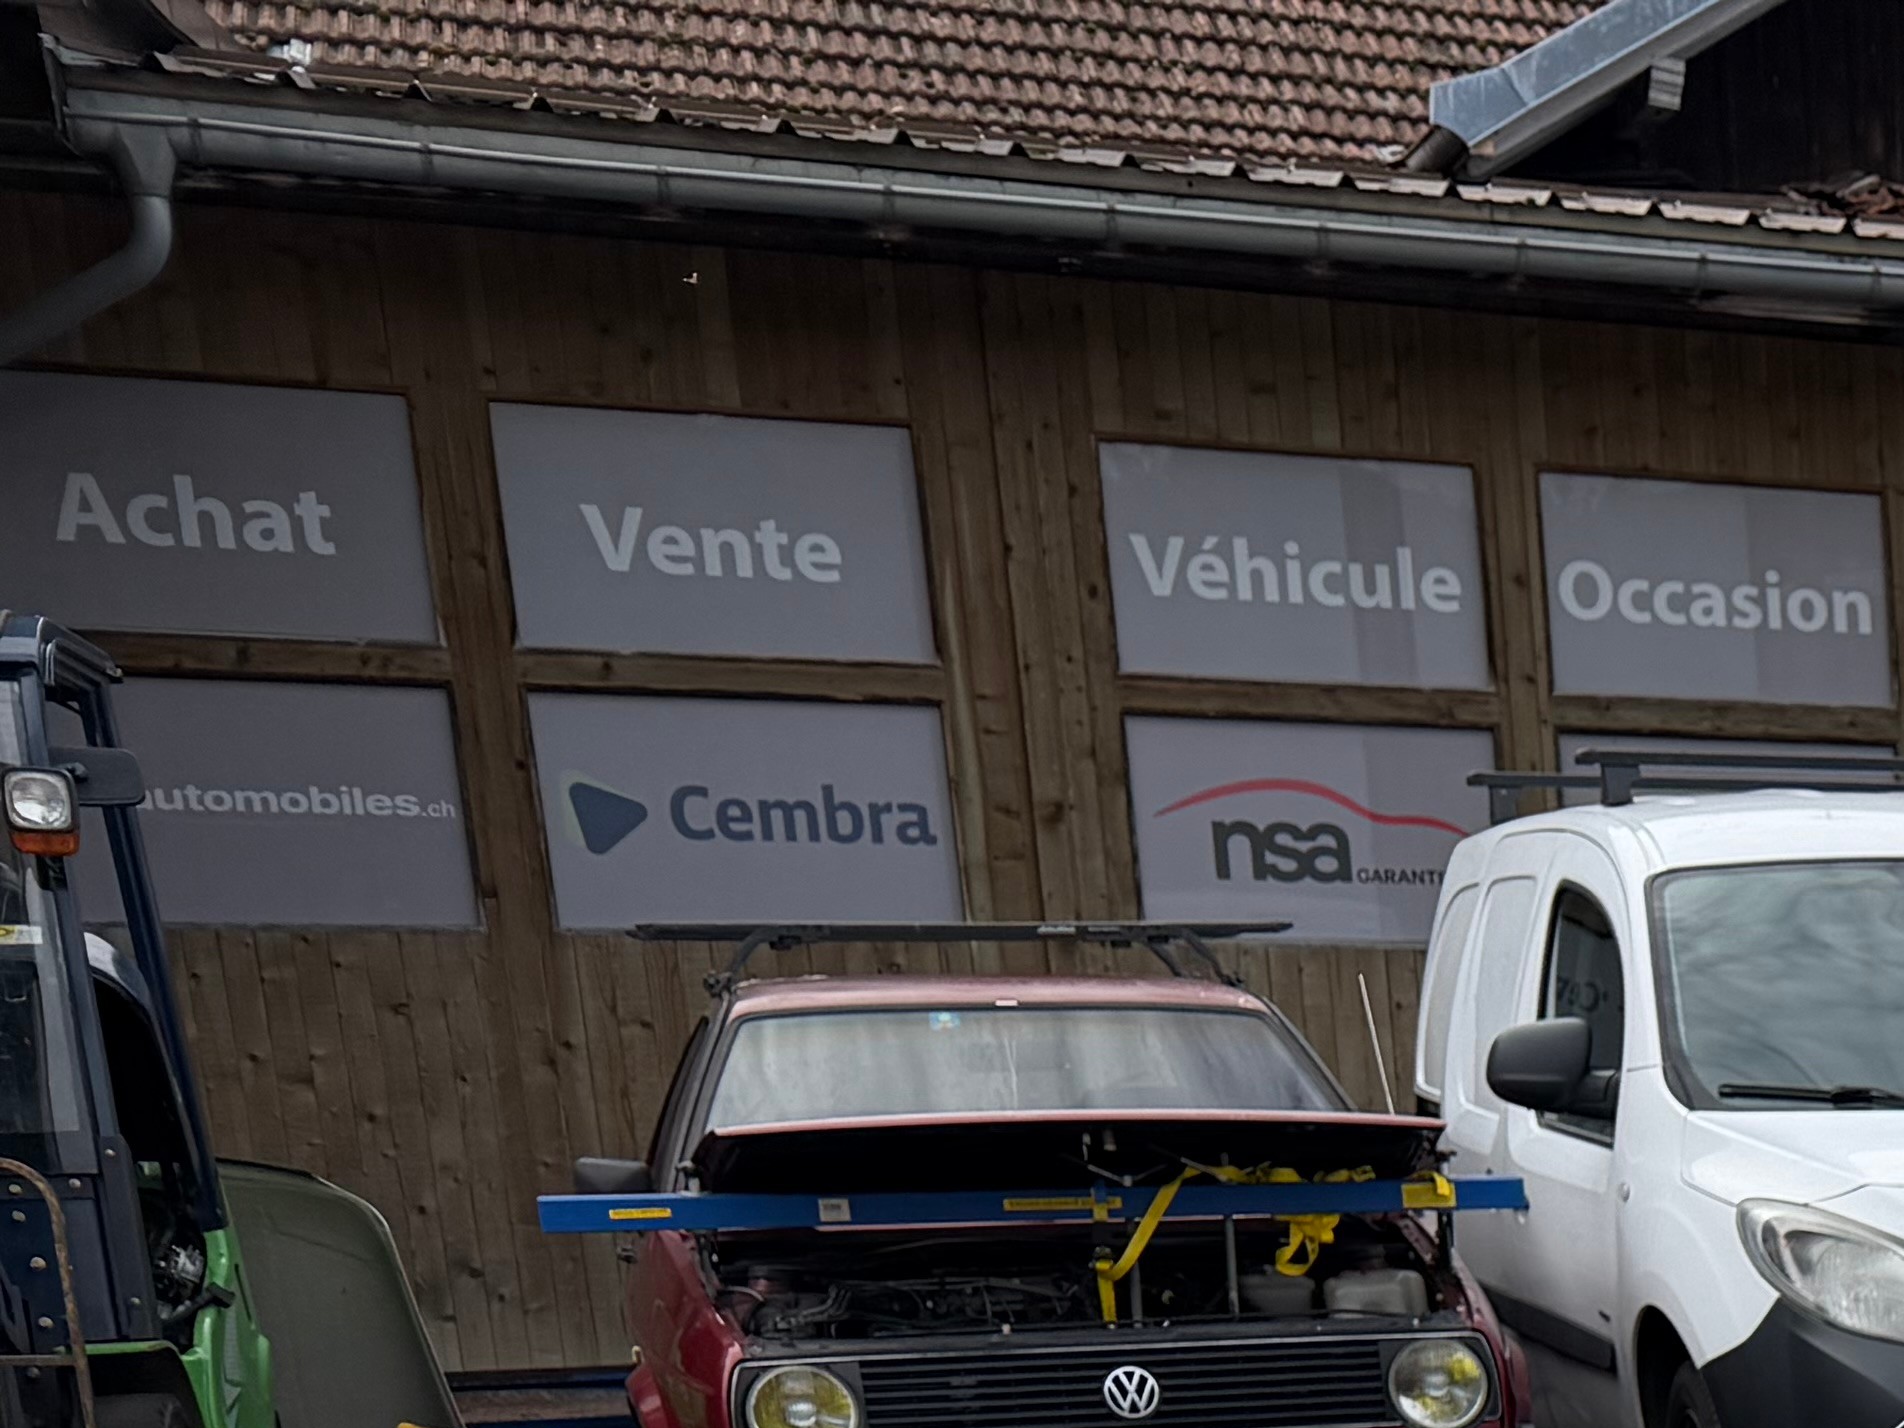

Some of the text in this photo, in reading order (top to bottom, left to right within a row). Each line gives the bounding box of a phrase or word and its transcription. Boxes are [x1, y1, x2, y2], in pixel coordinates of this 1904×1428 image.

[56, 472, 337, 556] Achat
[578, 503, 844, 583] Vente
[1128, 533, 1464, 614] Véhicule
[1557, 559, 1873, 636] Occasion
[669, 785, 938, 847] Cembra
[1211, 820, 1446, 885] nsa GARANTI
